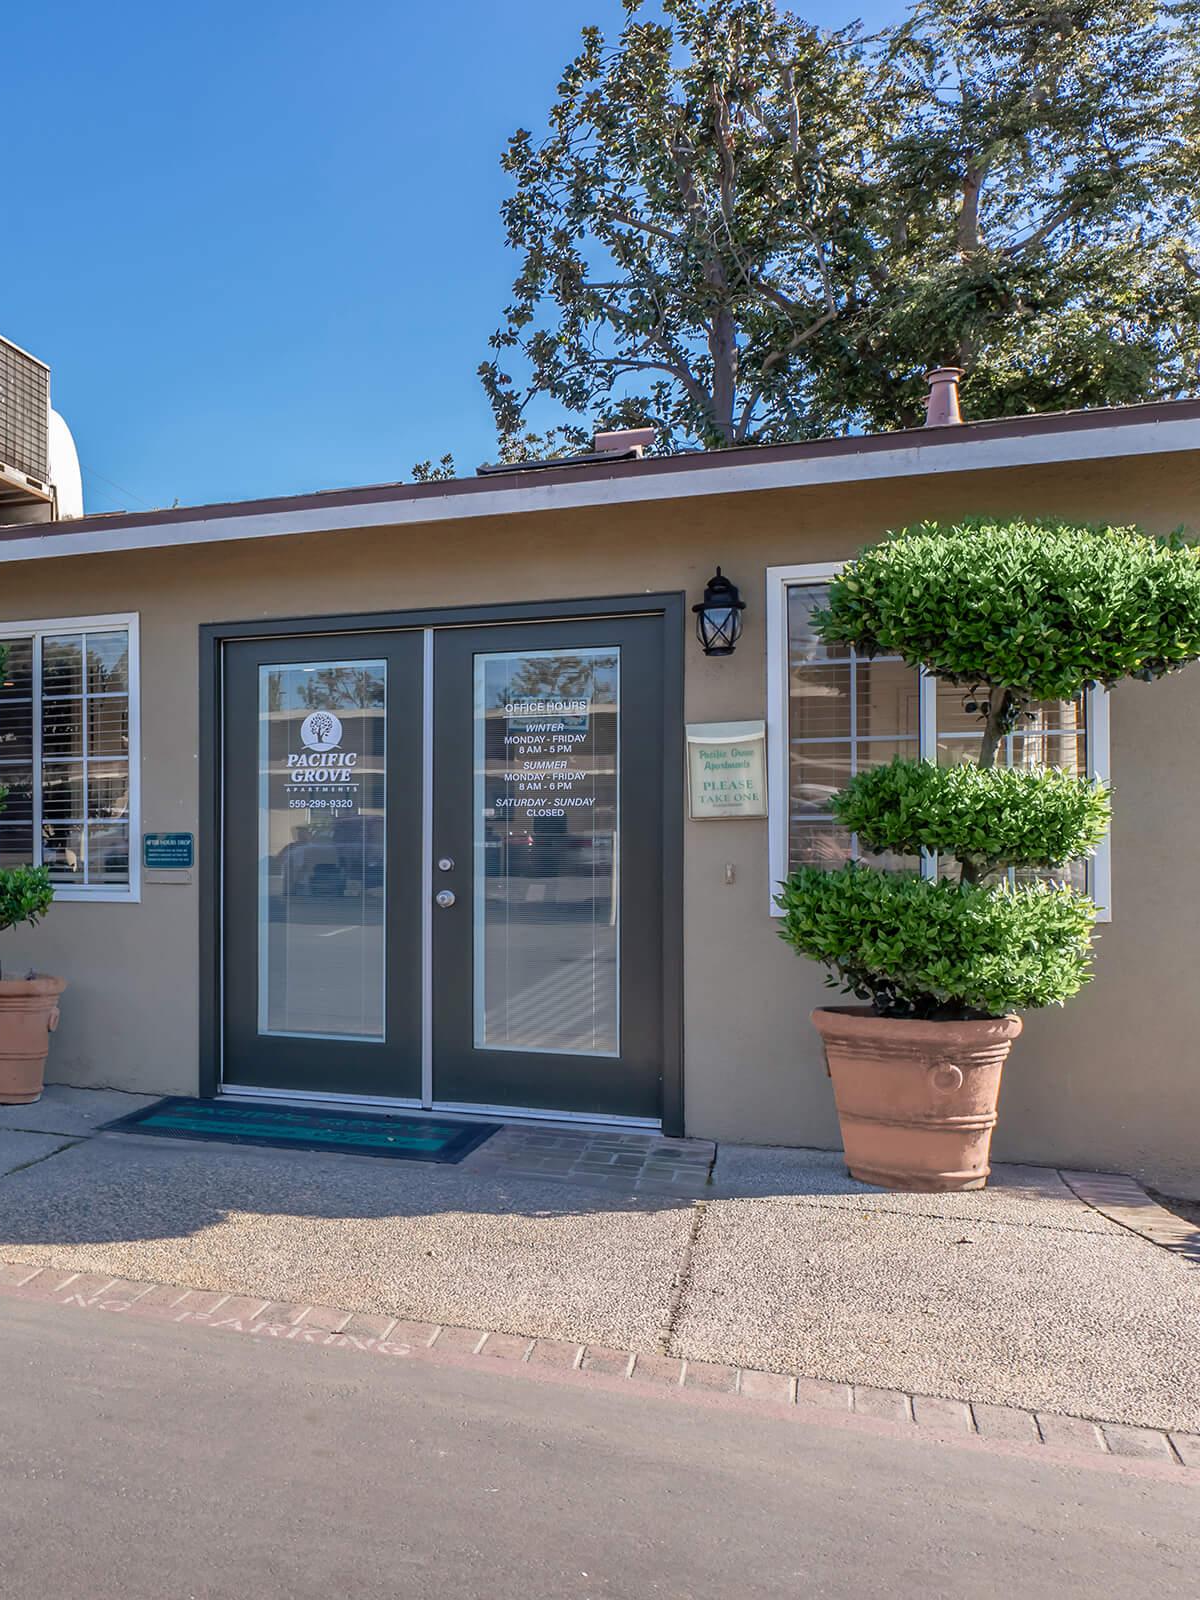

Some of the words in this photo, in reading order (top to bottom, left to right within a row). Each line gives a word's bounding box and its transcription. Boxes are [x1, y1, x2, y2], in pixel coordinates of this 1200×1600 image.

[505, 702, 544, 713] OFFICE
[546, 701, 587, 712] HOURS
[526, 723, 565, 733] WINTER
[504, 735, 546, 745] MONDAY
[552, 734, 587, 743] FRIDAY
[519, 746, 525, 754] 8
[526, 745, 542, 753] AM
[549, 745, 555, 753] 5
[557, 745, 572, 753] PM
[286, 753, 357, 768] PACIFIC
[523, 761, 568, 770] SUMMER
[291, 768, 352, 782] GROVE
[504, 773, 546, 782] MONDAY
[552, 772, 587, 781] FRIDAY
[519, 783, 525, 791] 8
[526, 782, 542, 791] AM
[549, 782, 555, 790] 6
[557, 782, 572, 790] PM
[703, 779, 753, 791] PLEASE
[495, 798, 547, 807] SATURDAY
[554, 797, 596, 807] SUNDAY
[700, 794, 728, 804] TAKE
[734, 792, 760, 802] ONE
[289, 799, 353, 809] 559-299-9320
[526, 808, 565, 817] CLOSED
[63, 1294, 132, 1312] NO
[174, 1311, 413, 1356] PARKING
